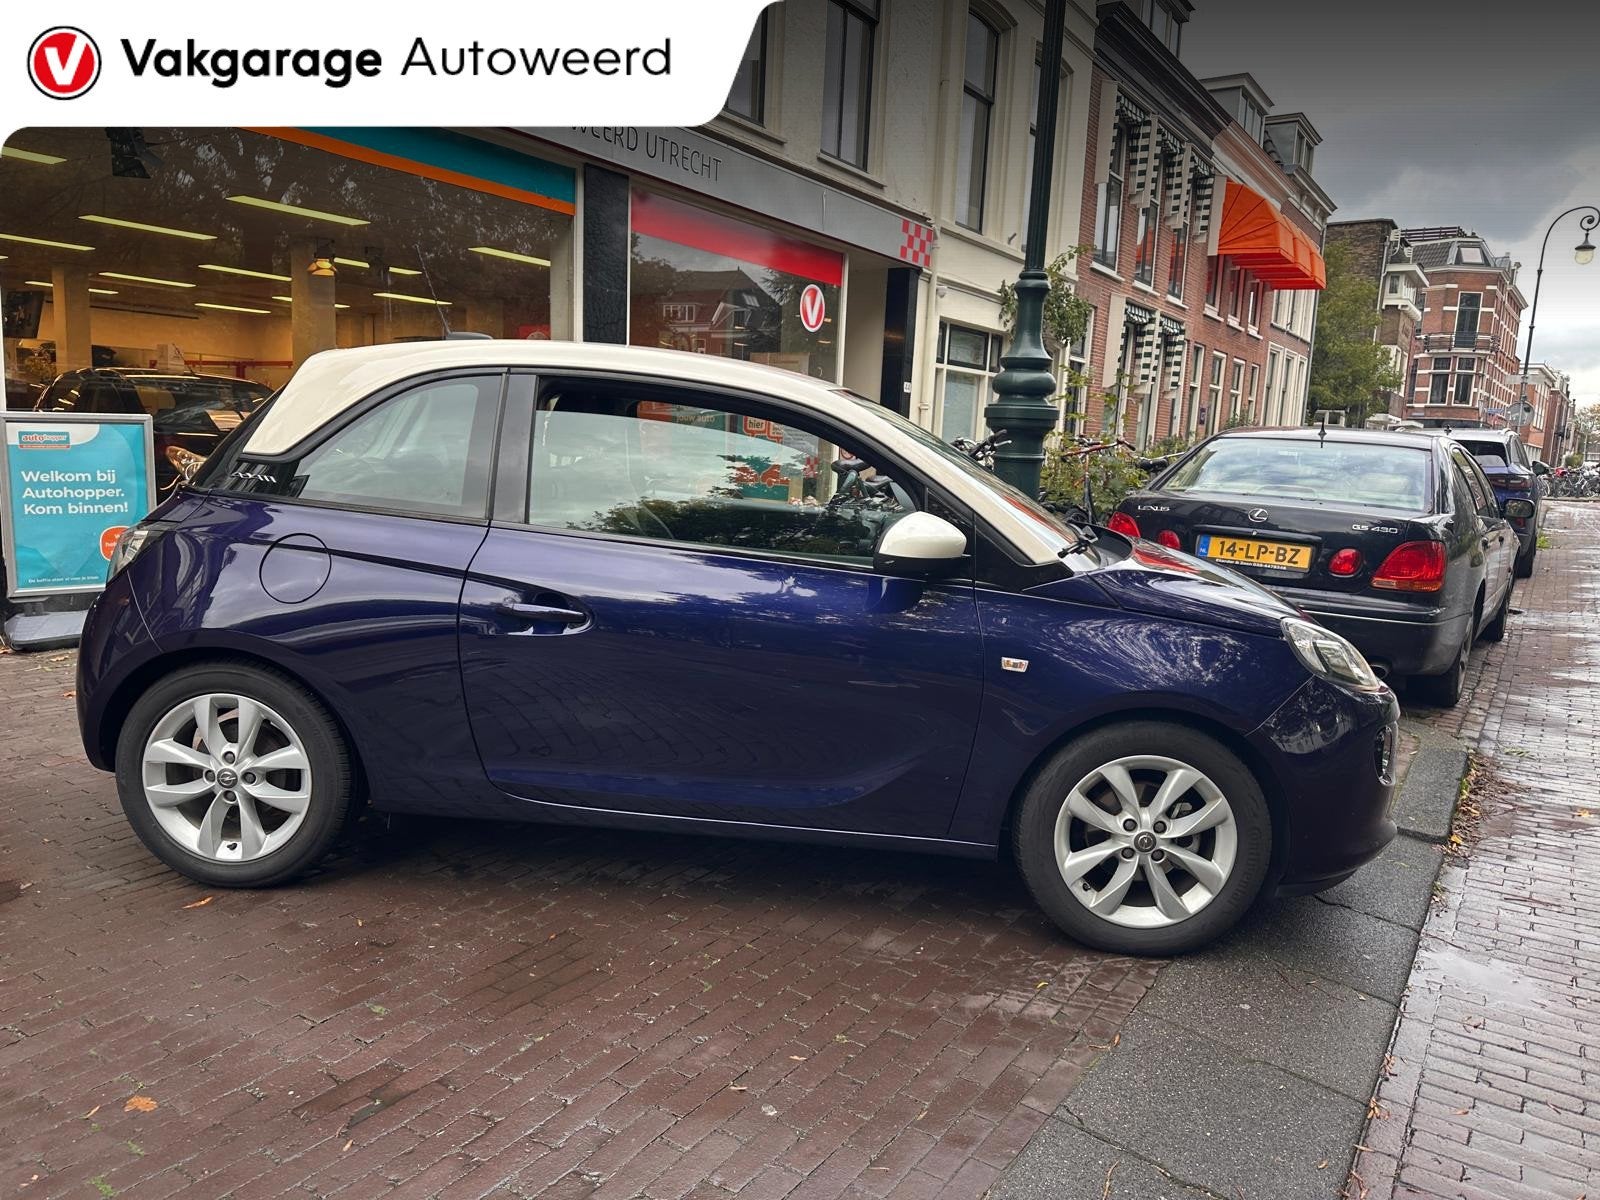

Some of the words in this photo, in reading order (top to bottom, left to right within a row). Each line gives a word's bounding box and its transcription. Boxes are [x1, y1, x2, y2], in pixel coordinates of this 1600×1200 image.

[571, 126, 638, 151] EERD
[646, 131, 722, 182] UTRECHT
[698, 414, 716, 422] auto
[749, 418, 764, 429] hier
[21, 470, 92, 482] Welkom
[96, 469, 116, 484] bij
[22, 487, 125, 500] Autohopper.
[24, 503, 63, 515] Kom
[68, 502, 129, 514] binnen!
[1371, 526, 1398, 534] 430
[1219, 540, 1301, 565] 14-LP-BZ
